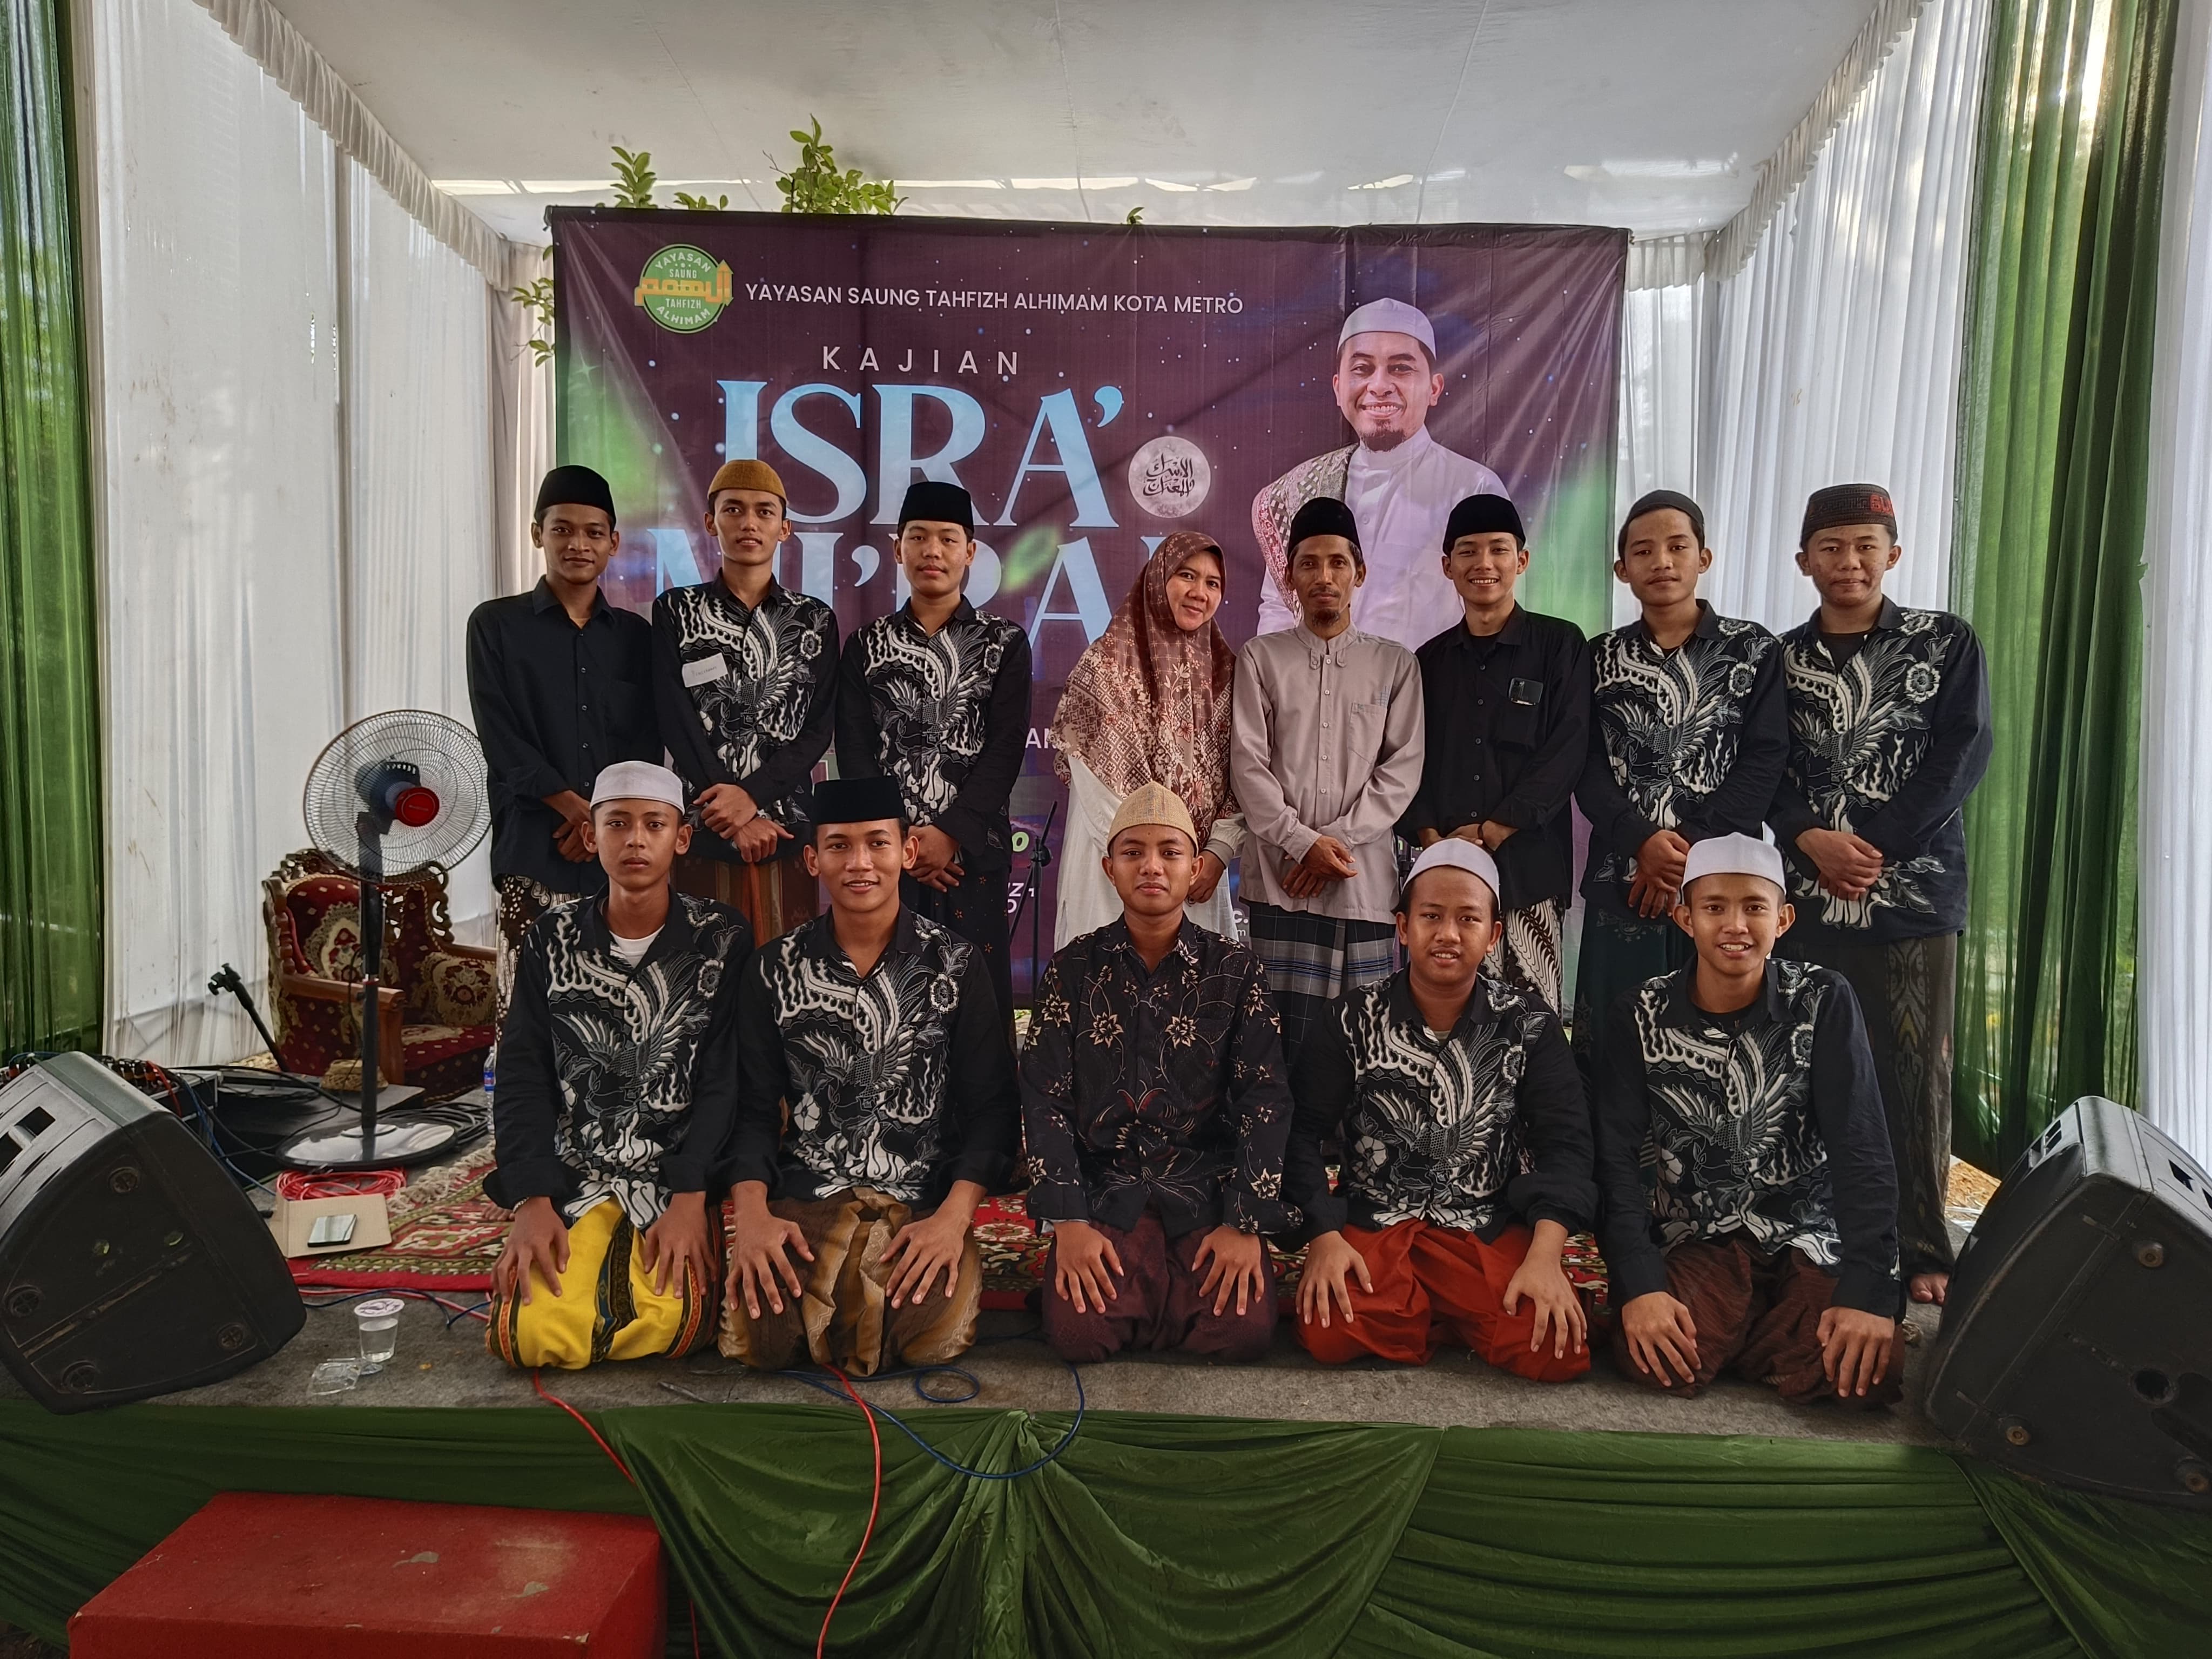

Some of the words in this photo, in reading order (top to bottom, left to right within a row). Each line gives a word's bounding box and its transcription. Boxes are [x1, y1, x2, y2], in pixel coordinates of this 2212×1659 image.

[655, 252, 711, 272] YAYASAN
[669, 269, 697, 279] SAUNG
[665, 298, 702, 309] TAHFIZH
[745, 284, 842, 304] YAYASAN
[847, 287, 920, 306] SAUNG
[925, 290, 1008, 308] TAHFIZH
[1014, 293, 1108, 311] ALHIMAM
[1114, 295, 1168, 312] KOTA
[1174, 296, 1243, 314] METRO
[656, 306, 711, 325] ALHIMAM
[822, 346, 1017, 375] KAJIAN
[647, 529, 1166, 648] I'A
